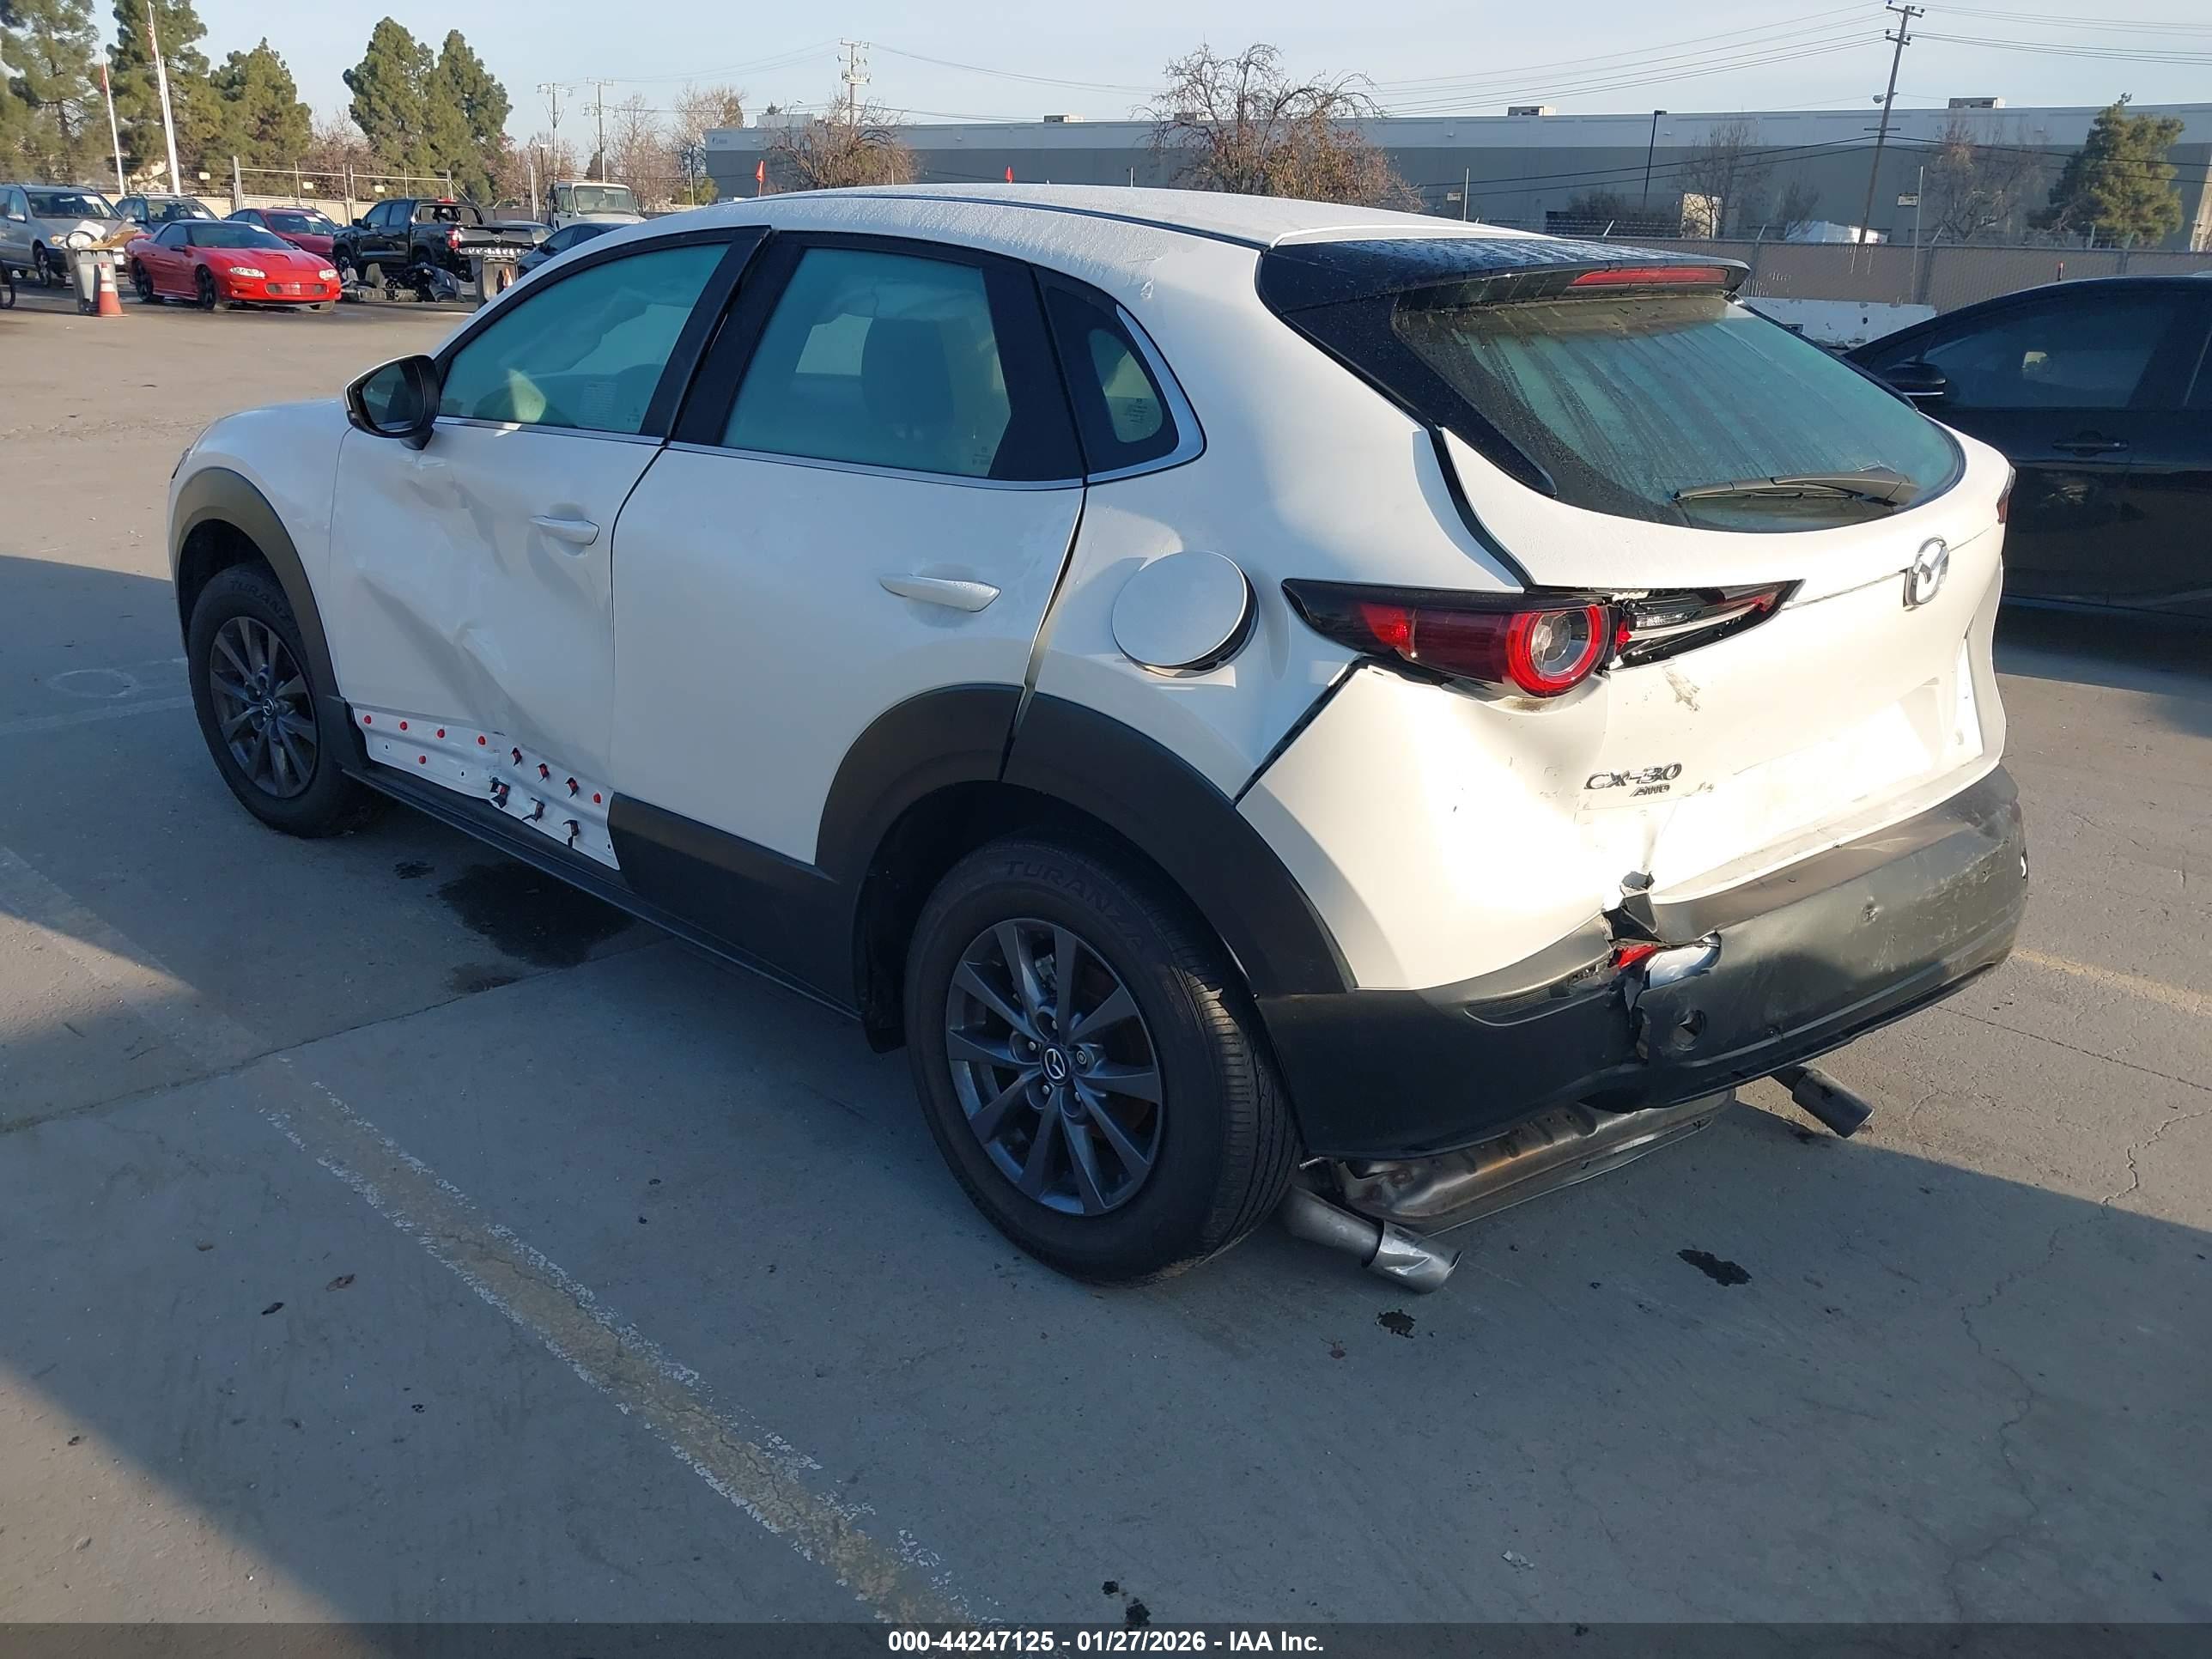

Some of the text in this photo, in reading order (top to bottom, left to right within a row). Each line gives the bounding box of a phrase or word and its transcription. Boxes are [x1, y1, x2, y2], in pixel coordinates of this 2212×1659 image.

[1584, 762, 1683, 790] CX-30
[1629, 783, 1671, 798] AWD
[1003, 860, 1144, 951] TURANZA
